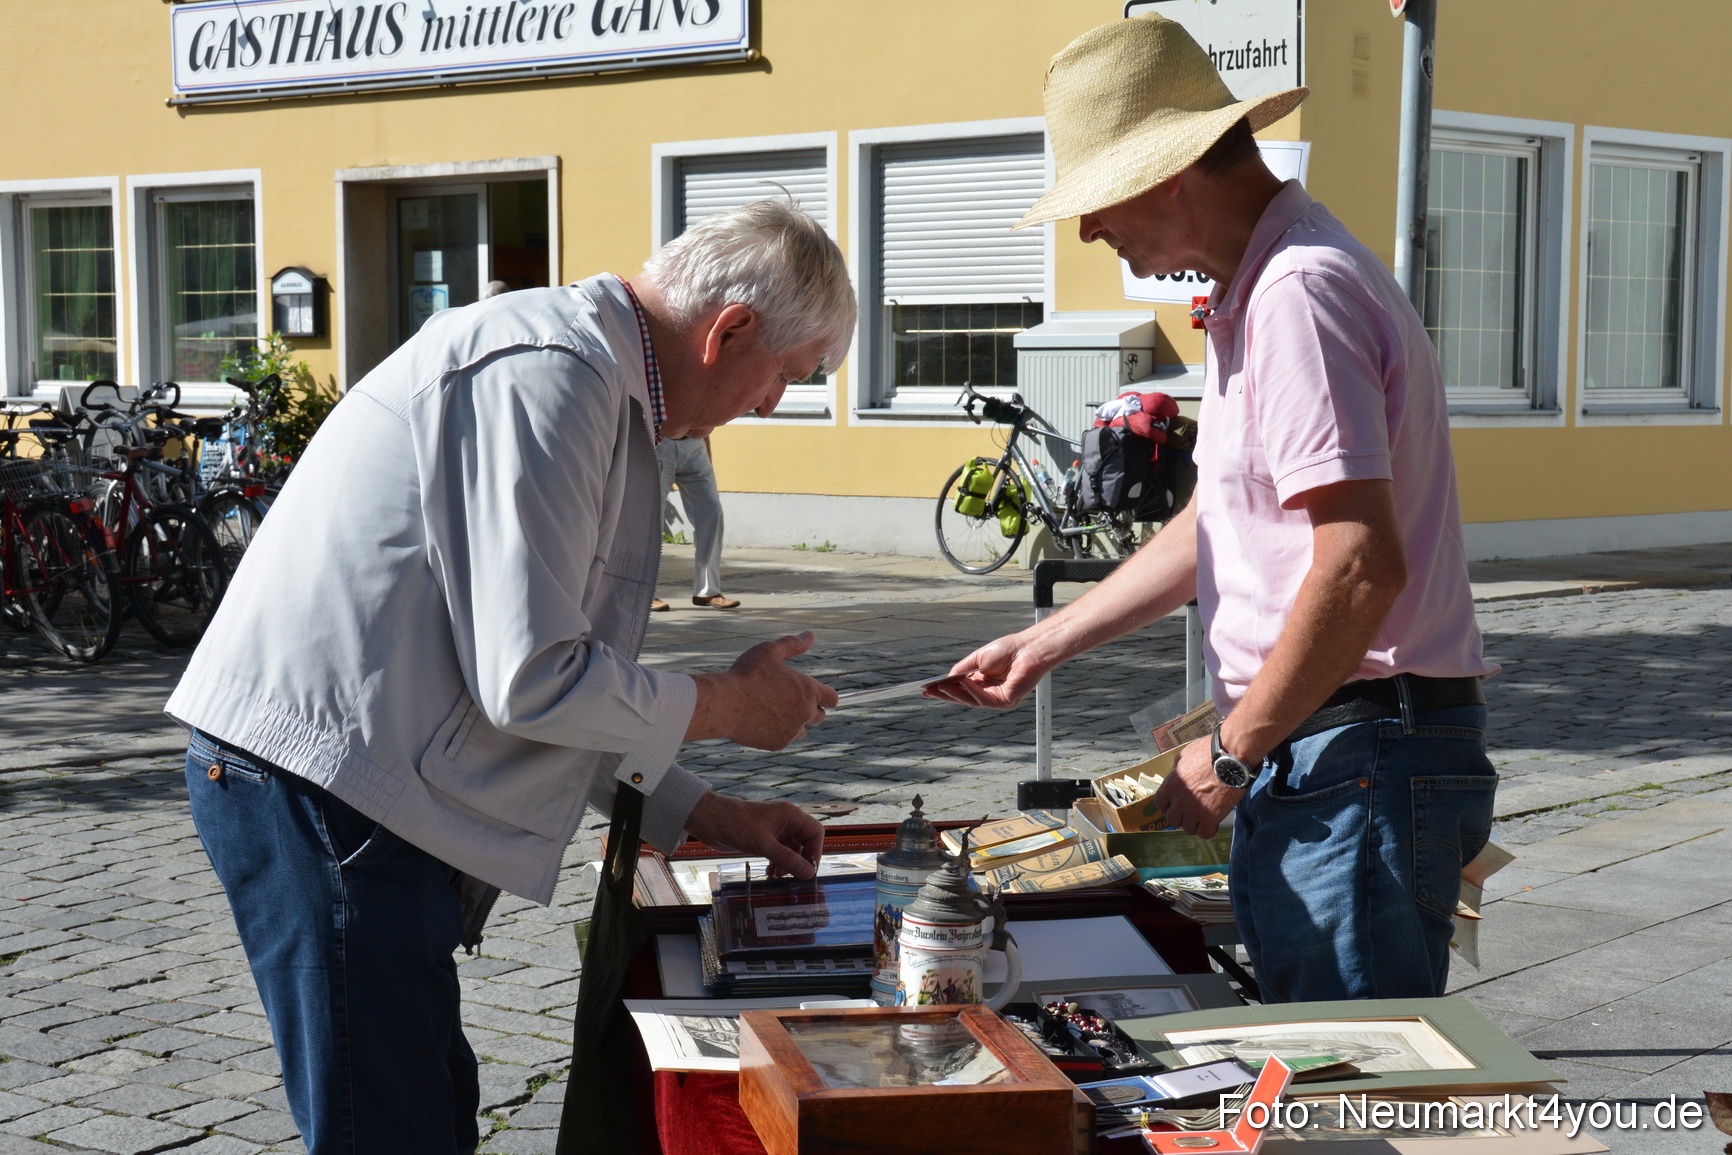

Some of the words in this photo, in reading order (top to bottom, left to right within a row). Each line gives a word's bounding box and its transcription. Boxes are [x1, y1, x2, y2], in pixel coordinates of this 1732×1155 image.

[188, 2, 407, 73] GASTHAUS
[419, 1, 576, 53] mittlere
[591, 0, 721, 37] GANS
[1208, 38, 1288, 72] hrzufahrt
